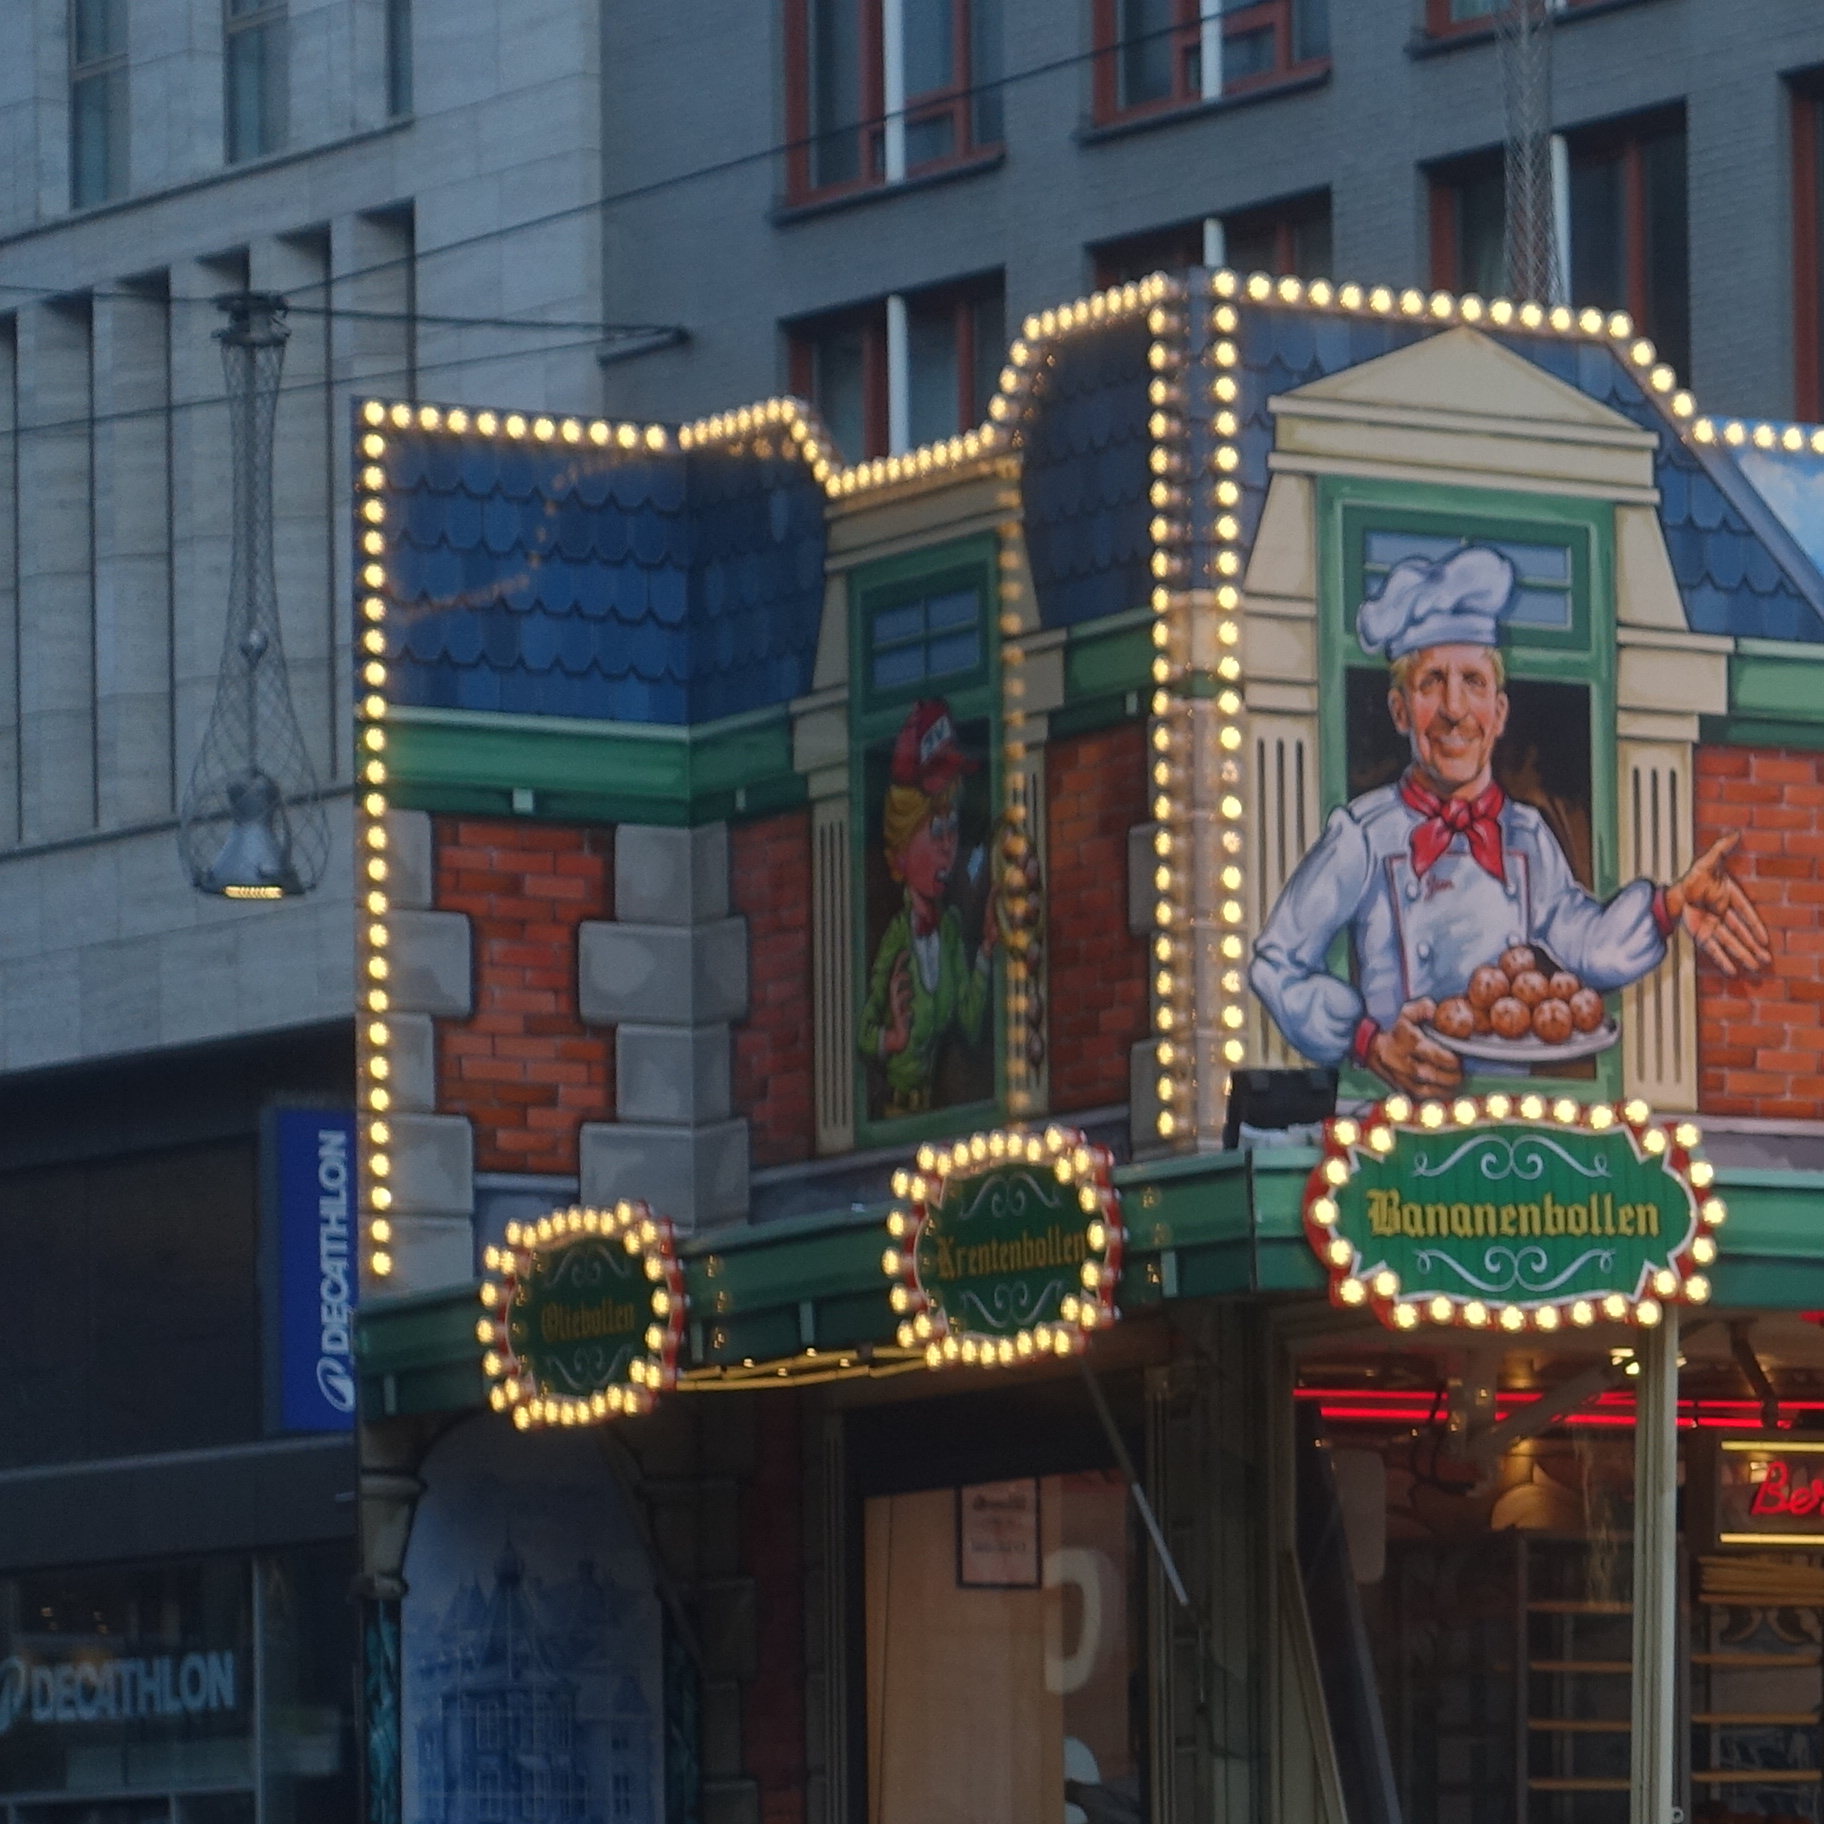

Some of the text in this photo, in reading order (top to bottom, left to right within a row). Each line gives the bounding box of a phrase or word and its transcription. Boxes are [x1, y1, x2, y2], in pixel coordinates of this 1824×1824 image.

[1364, 1186, 1661, 1238] Bananenbollen
[318, 1129, 350, 1356] DECATHLON
[935, 1222, 1088, 1282] Krentenbollen
[540, 1300, 636, 1344] Oliebollen
[30, 1649, 236, 1723] DECATHLON
